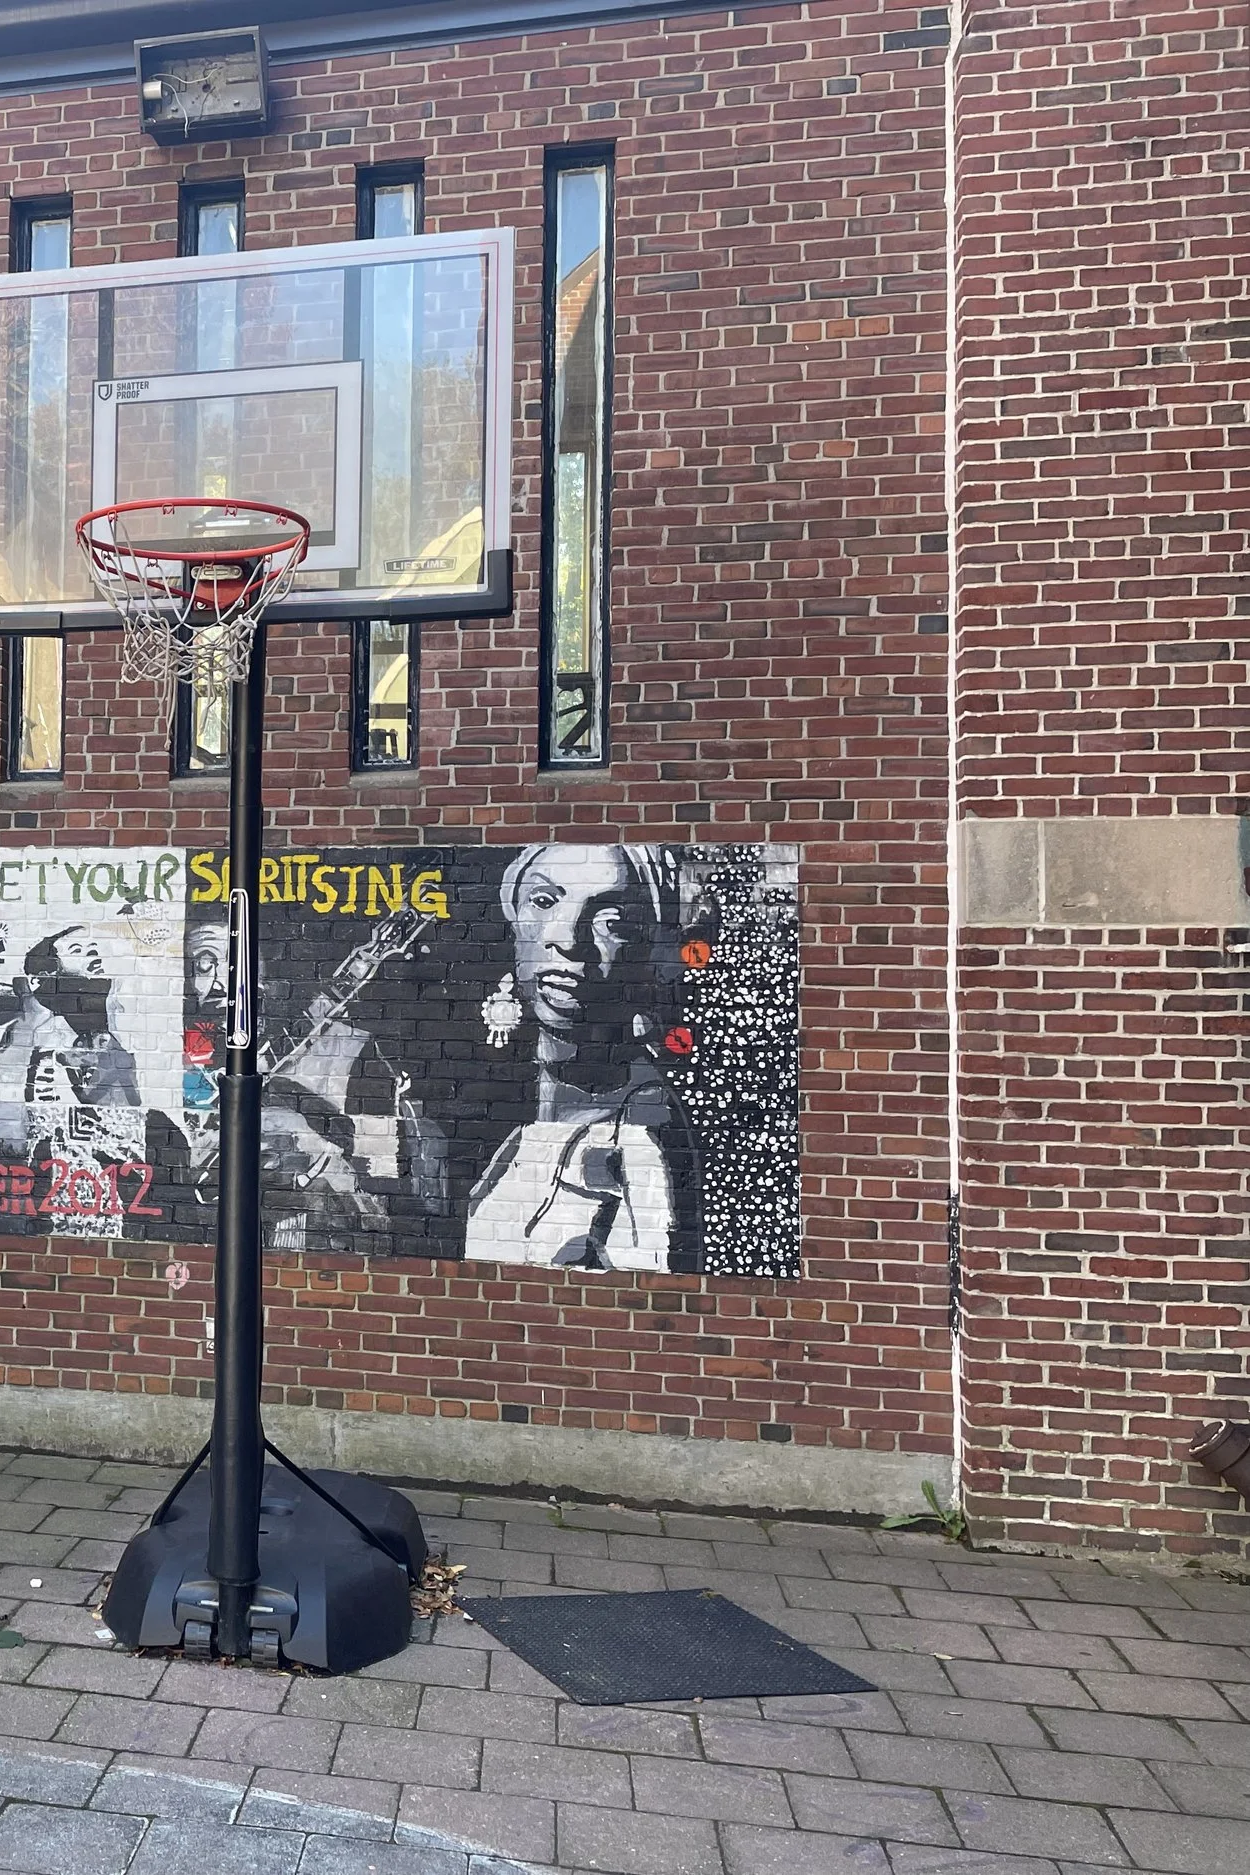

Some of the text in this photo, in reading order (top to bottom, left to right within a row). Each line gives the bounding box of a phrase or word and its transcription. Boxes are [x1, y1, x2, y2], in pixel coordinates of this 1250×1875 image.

[116, 381, 150, 391] SHATTER
[116, 390, 141, 399] PROOF
[393, 560, 447, 571] LIFETIME
[64, 853, 180, 904] YOUR
[312, 863, 451, 919] SING
[38, 1158, 163, 1216] 2012
